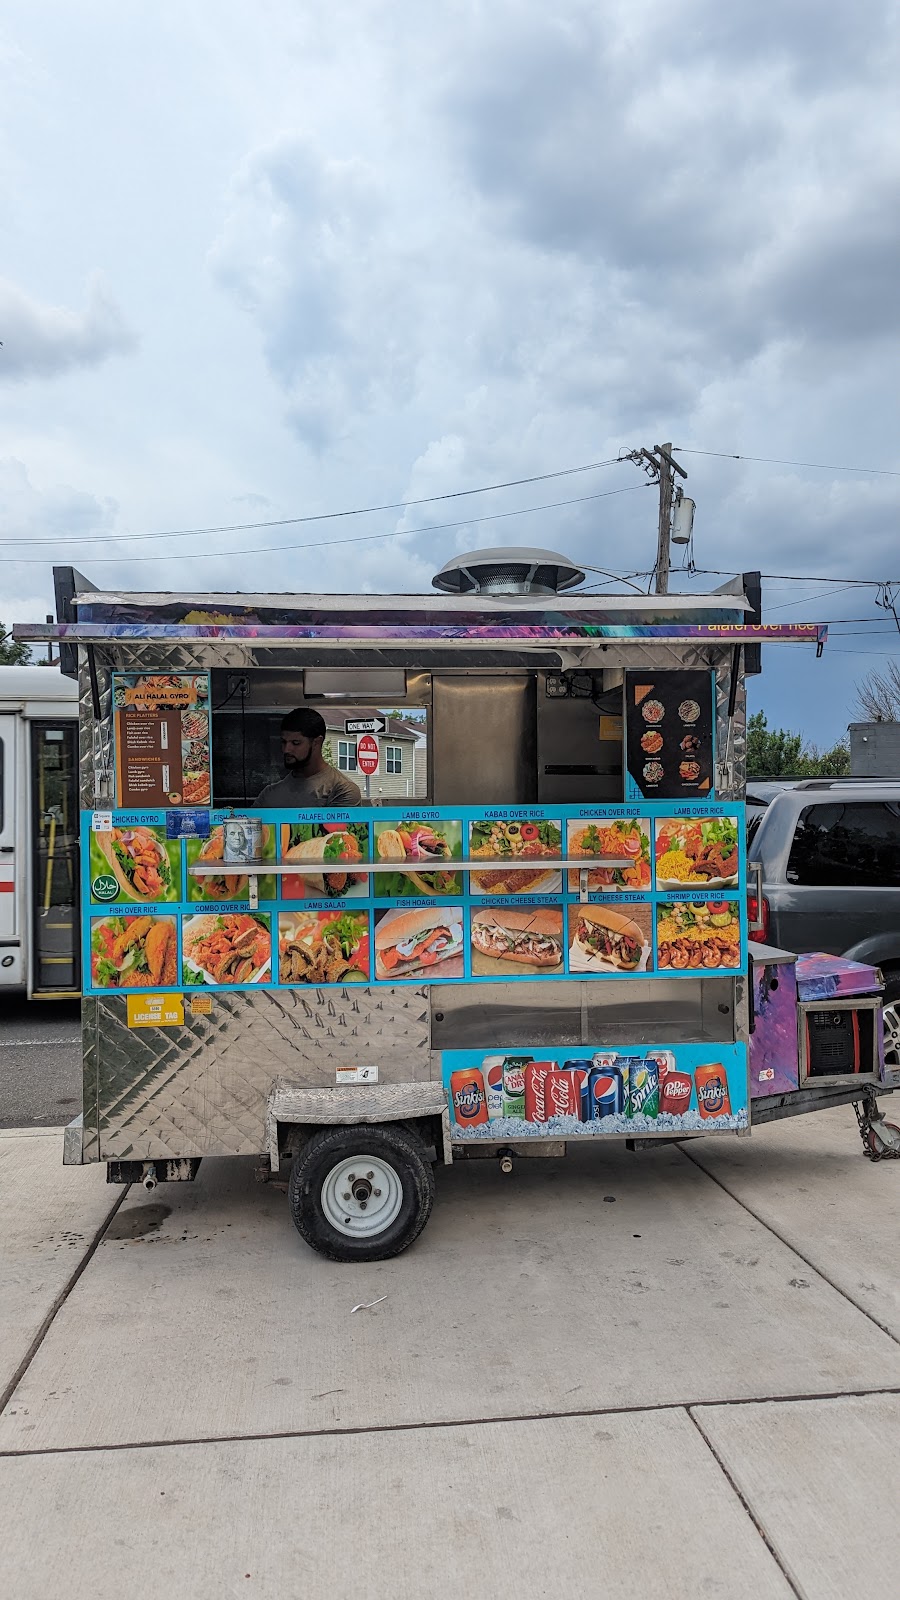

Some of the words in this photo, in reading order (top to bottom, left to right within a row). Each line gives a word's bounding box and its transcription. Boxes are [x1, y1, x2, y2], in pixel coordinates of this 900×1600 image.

[666, 1082, 689, 1096] Pepper
[675, 1081, 685, 1089] Dr
[631, 1075, 657, 1112] Sprite
